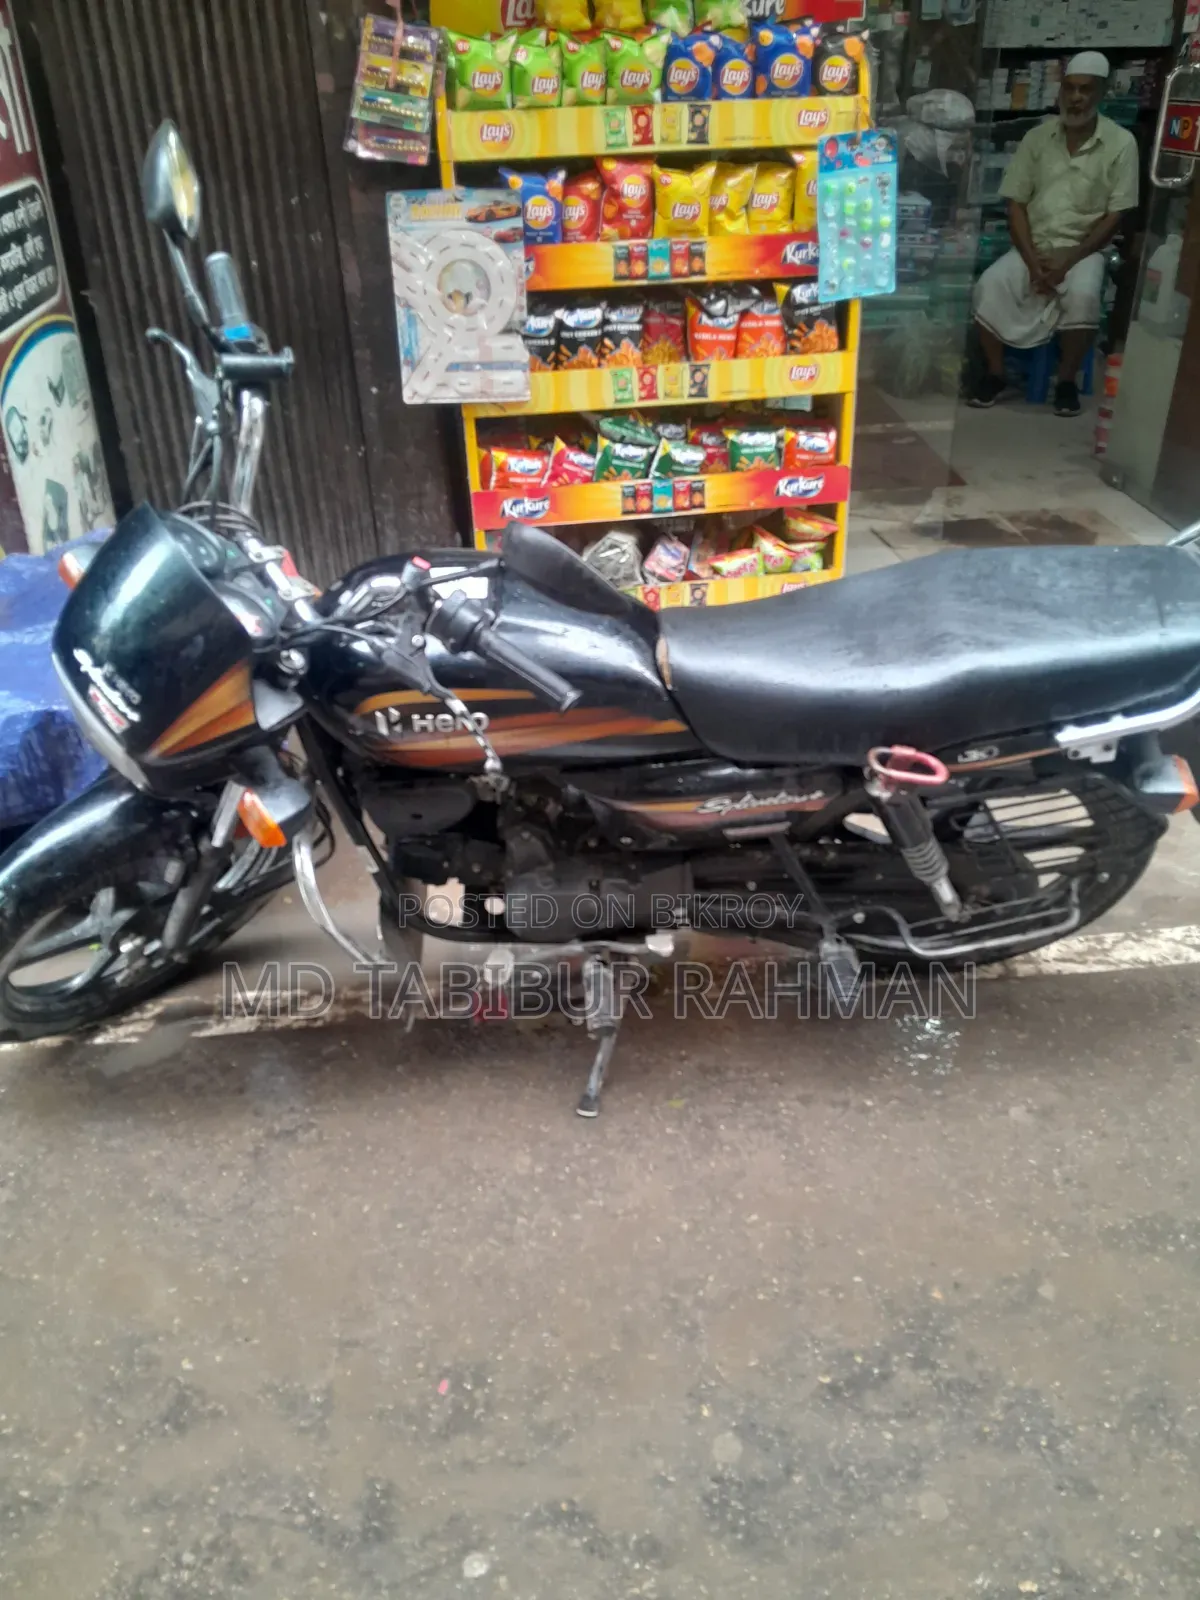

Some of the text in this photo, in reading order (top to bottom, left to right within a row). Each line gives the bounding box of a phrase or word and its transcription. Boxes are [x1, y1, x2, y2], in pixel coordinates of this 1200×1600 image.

[473, 70, 502, 90] Lay's
[621, 69, 651, 89] Lay's
[668, 66, 699, 86] Lay's
[722, 67, 750, 87] Lay's
[771, 62, 803, 82] Lay's
[821, 64, 850, 84] Lay's
[533, 77, 559, 95] Lay's
[799, 108, 829, 126] Lay's
[481, 122, 512, 142] Lay's
[621, 181, 647, 199] Lay's
[752, 192, 779, 210] Lay's
[525, 204, 554, 221] Lay's
[563, 204, 586, 222] ay's
[672, 202, 700, 219] Lay's
[790, 365, 817, 381] Lay's
